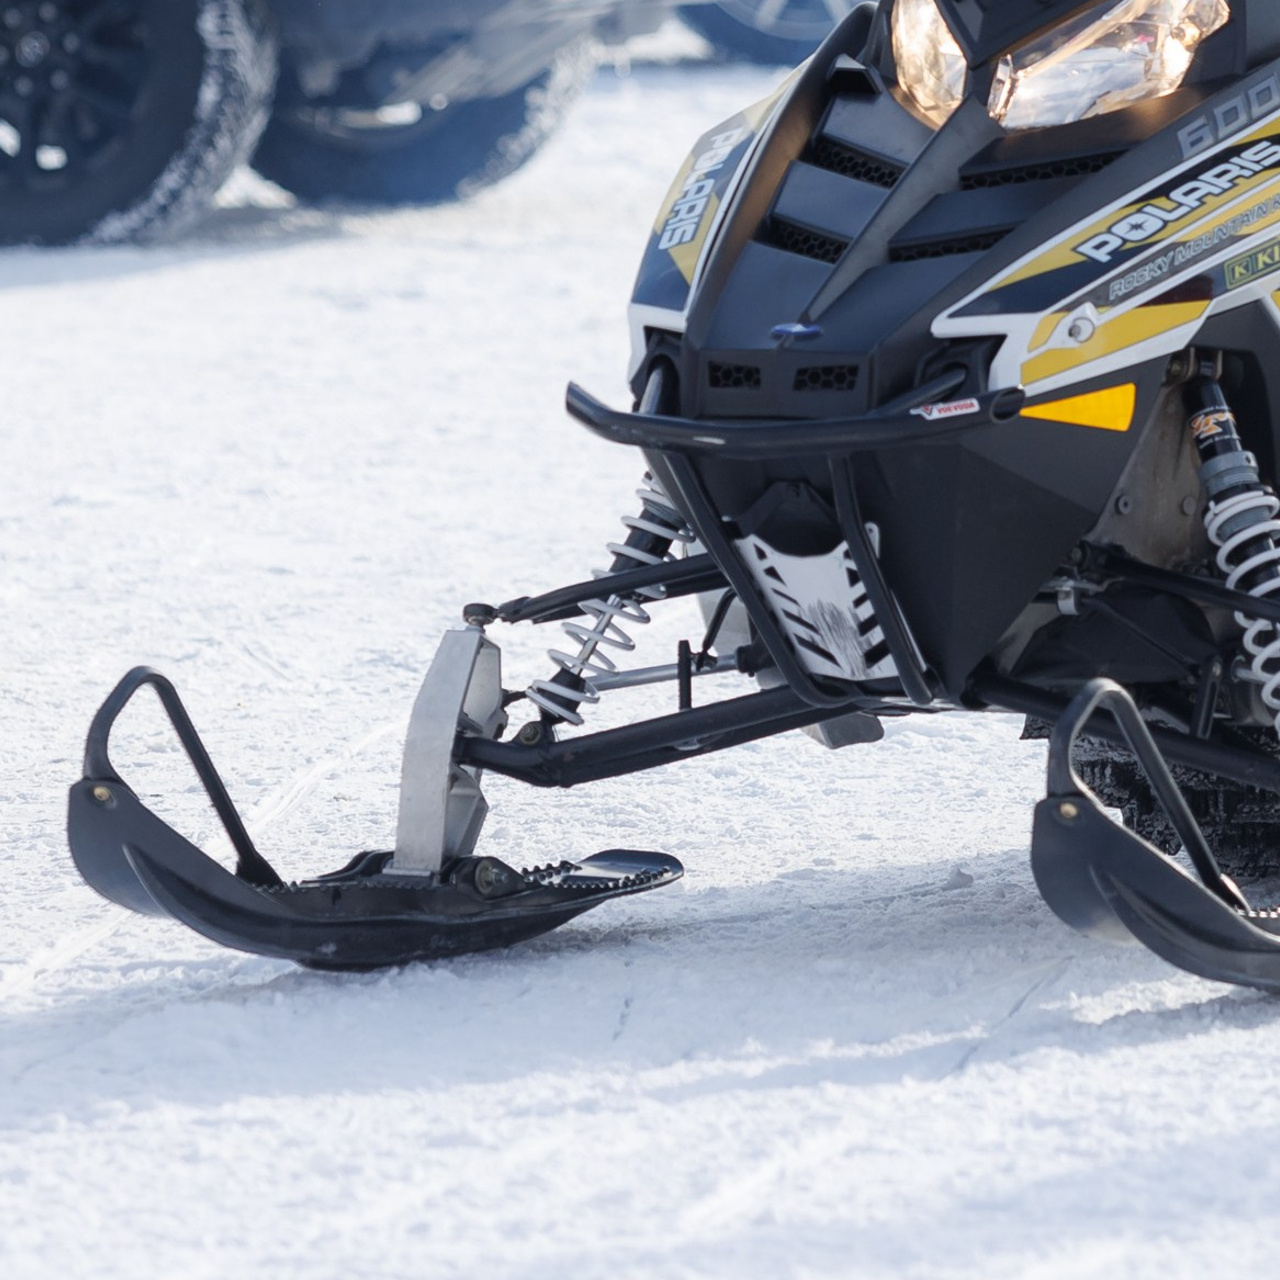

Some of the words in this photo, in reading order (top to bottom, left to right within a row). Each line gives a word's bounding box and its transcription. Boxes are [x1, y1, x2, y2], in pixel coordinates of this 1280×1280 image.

[1177, 73, 1280, 160] 600
[658, 126, 745, 251] POLARIS
[1109, 251, 1173, 300] ROCKY
[1174, 205, 1269, 266] MOUNTAIN
